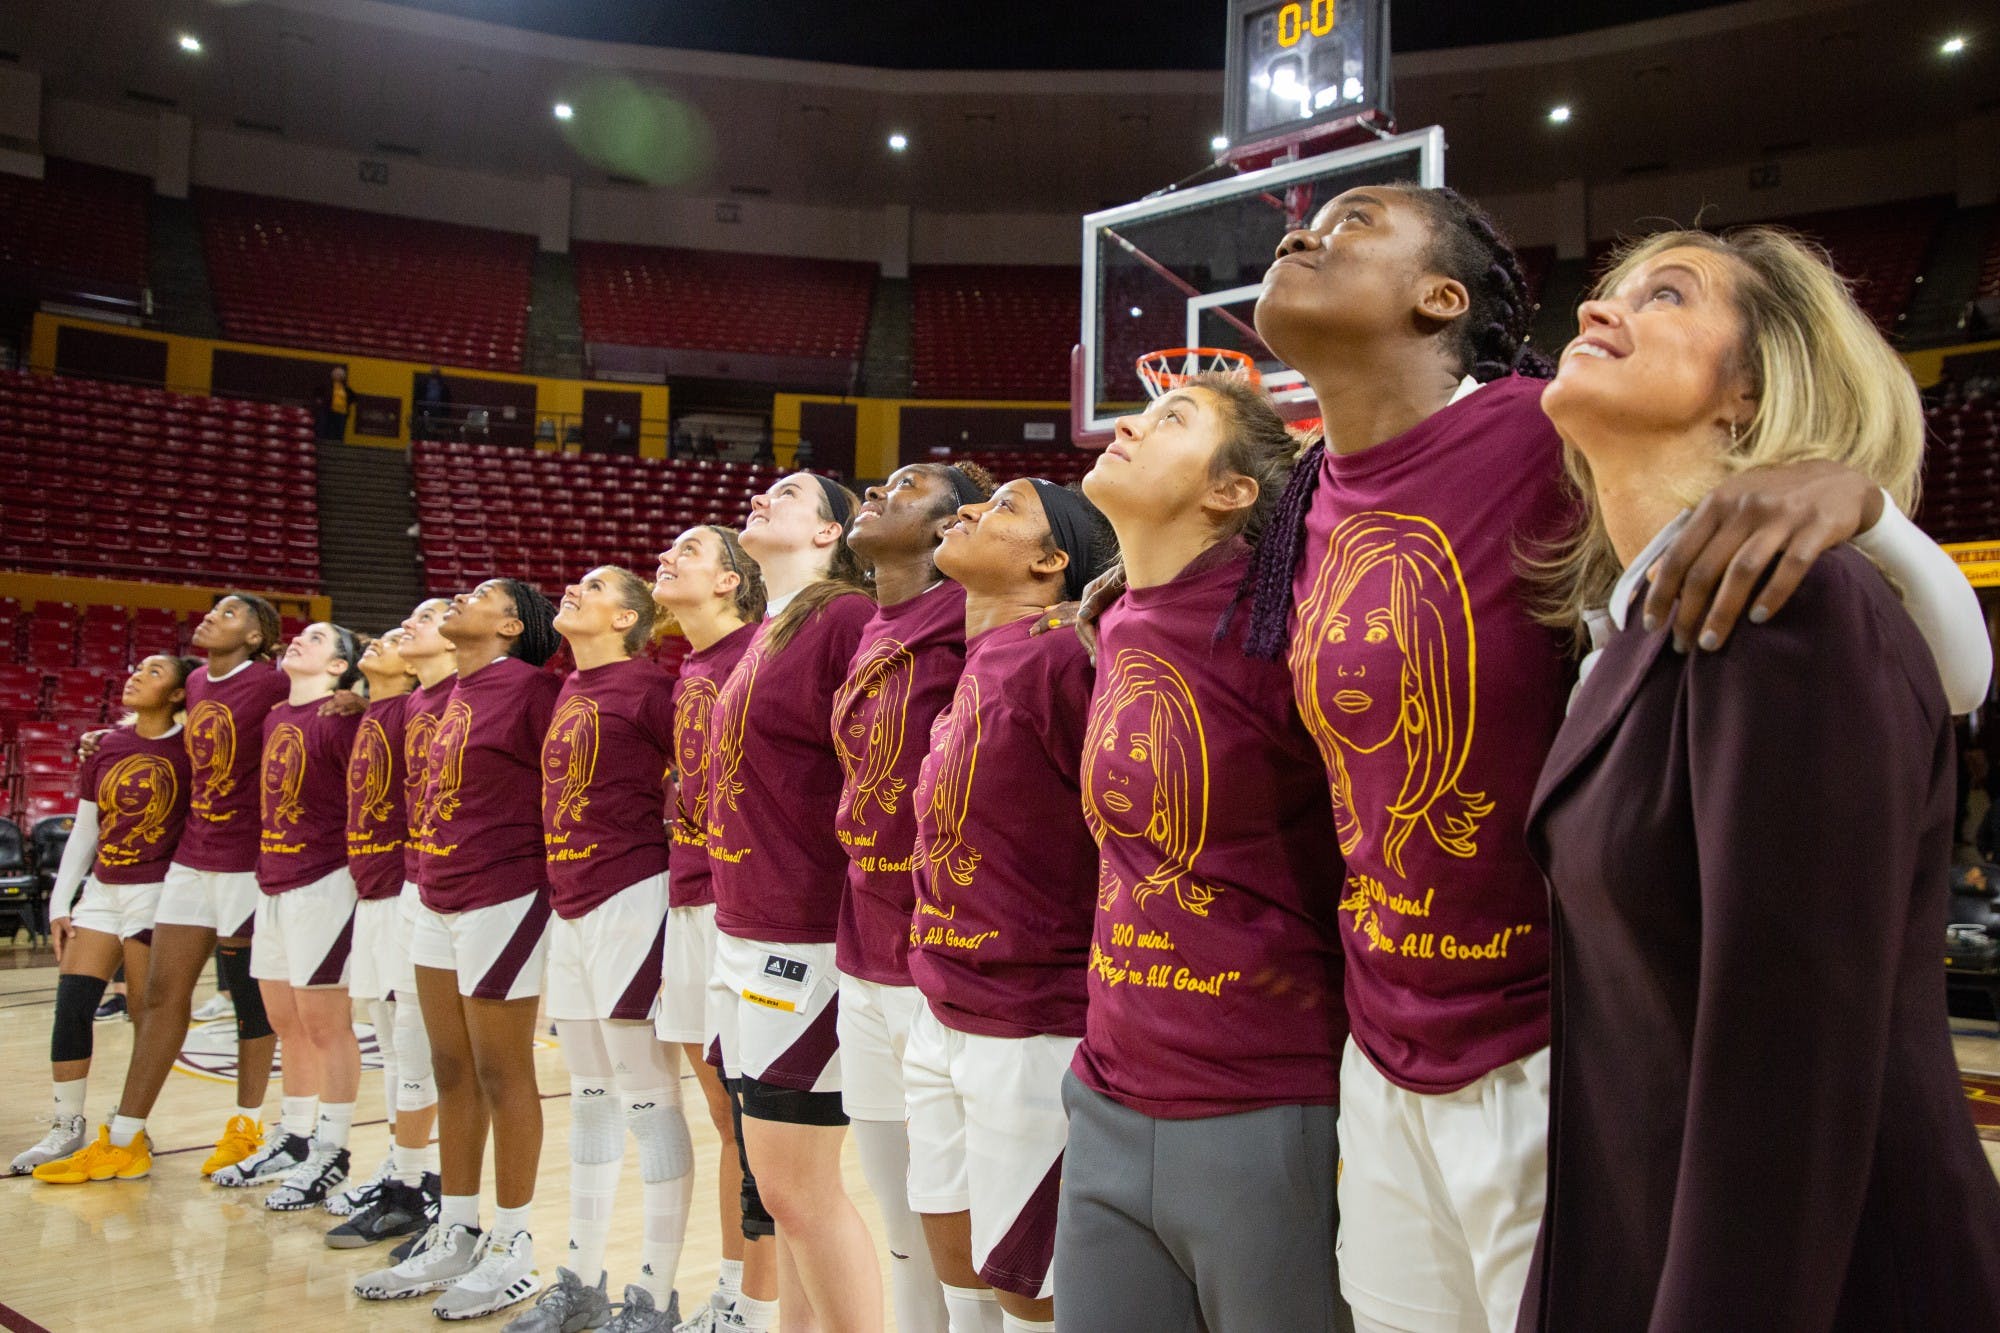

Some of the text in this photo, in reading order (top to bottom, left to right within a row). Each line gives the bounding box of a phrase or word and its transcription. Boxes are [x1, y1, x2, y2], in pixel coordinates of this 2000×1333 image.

[923, 926, 944, 945] All
[1400, 933, 1435, 959] All
[1440, 924, 1532, 960] Good!"
[1146, 965, 1173, 989] All
